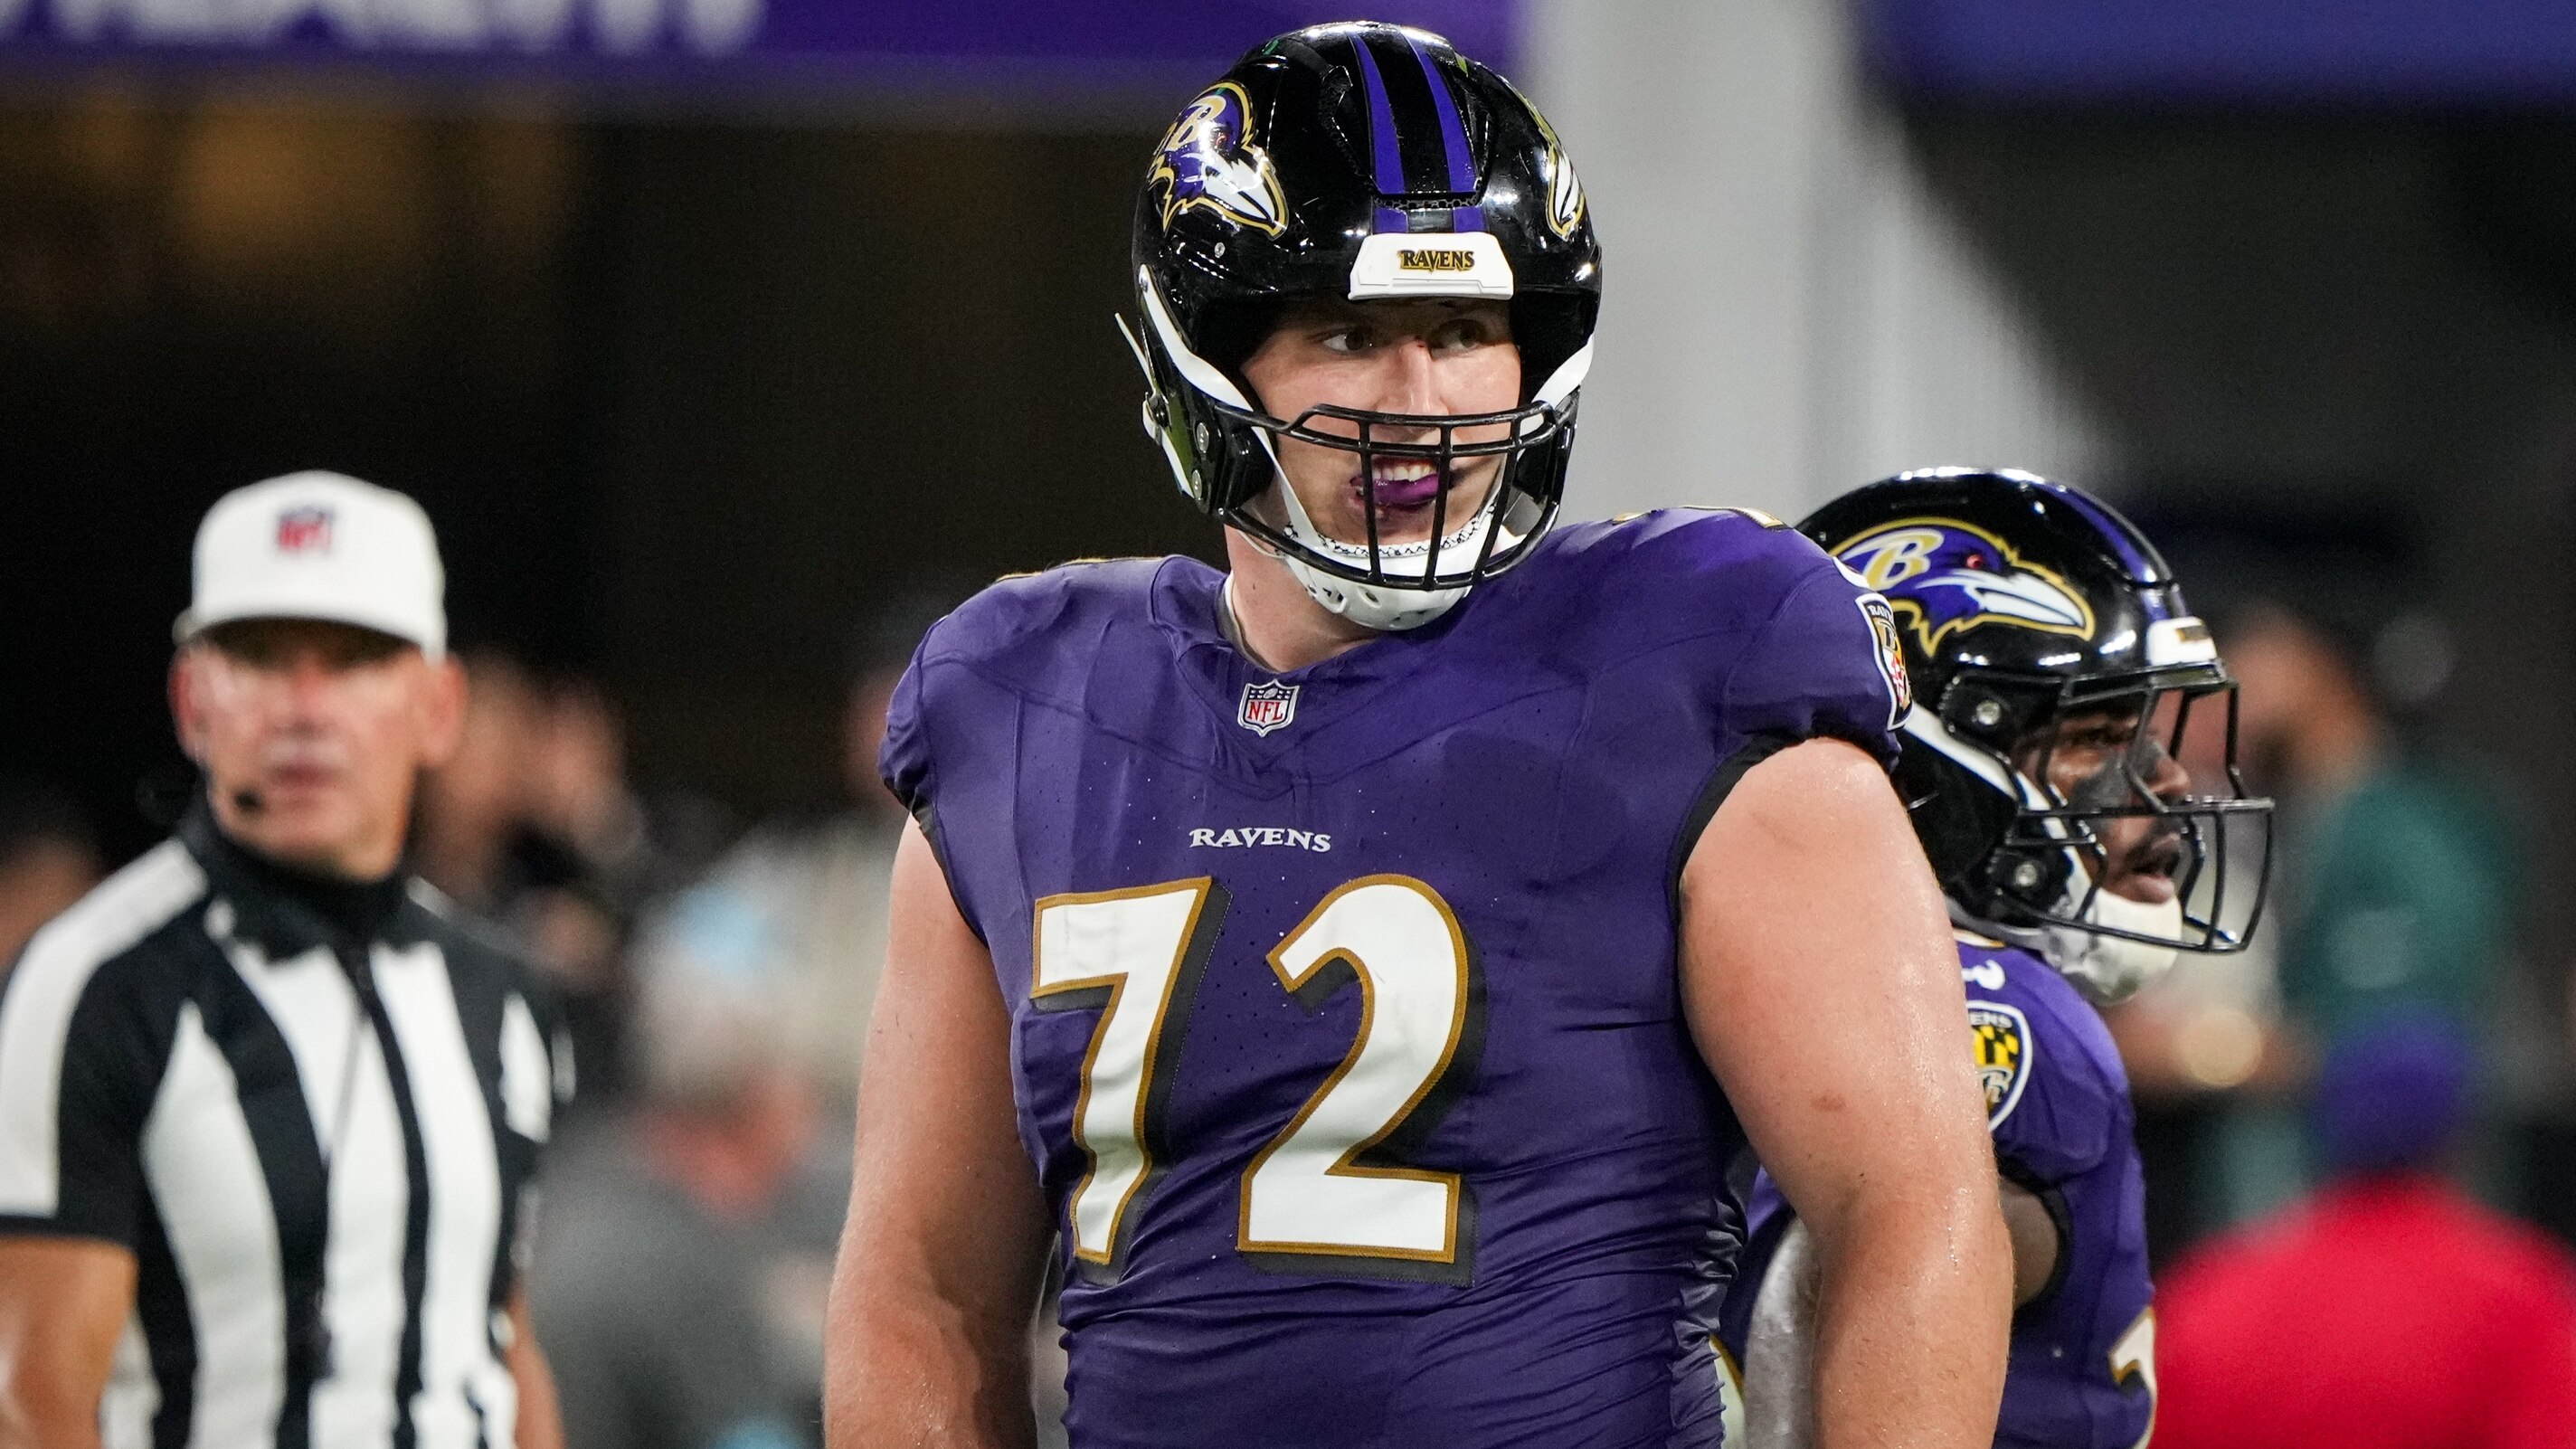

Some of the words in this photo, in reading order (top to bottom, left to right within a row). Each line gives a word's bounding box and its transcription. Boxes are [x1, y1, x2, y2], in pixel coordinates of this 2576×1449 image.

[1397, 249, 1475, 274] RAVENS
[1840, 527, 1945, 591] B
[1246, 700, 1283, 724] NFL
[1189, 827, 1332, 853] RAVENS
[1968, 1011, 2013, 1029] ENS
[1031, 872, 1471, 1266] 72
